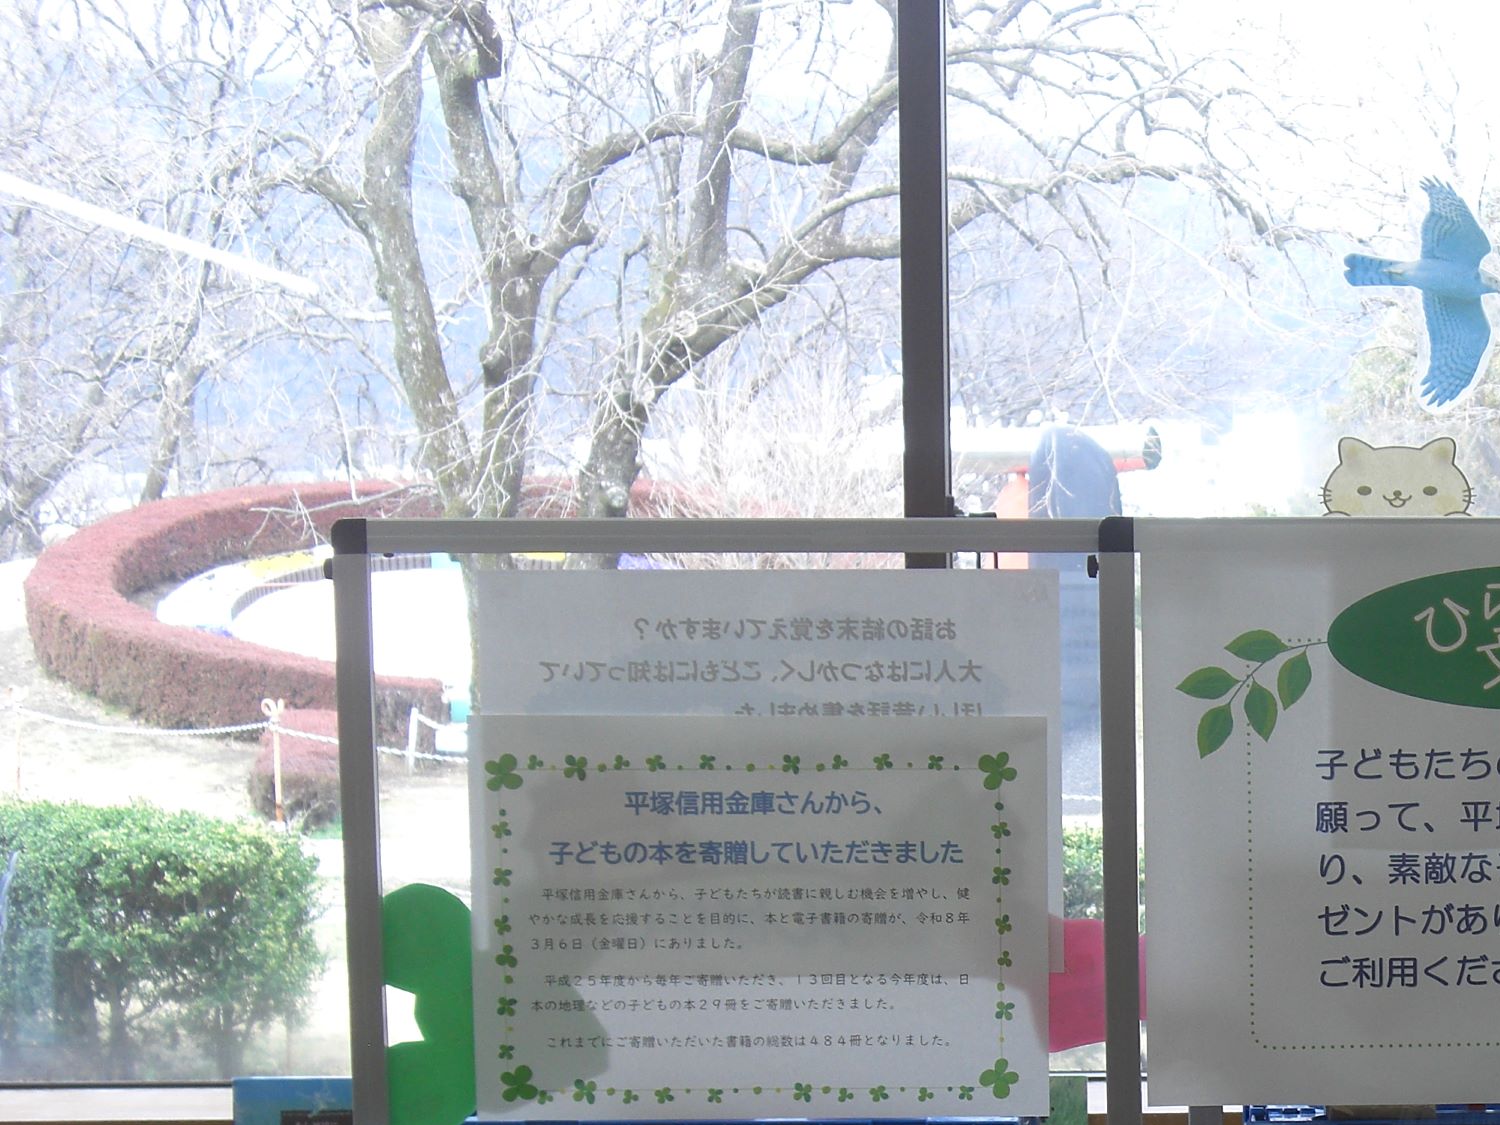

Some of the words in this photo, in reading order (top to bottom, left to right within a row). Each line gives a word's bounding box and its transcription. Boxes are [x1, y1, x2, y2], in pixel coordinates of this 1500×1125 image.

[624, 791, 882, 816] 平塚信用金庫さんから、
[549, 840, 964, 867] 子どもの本を寄贈していただきました
